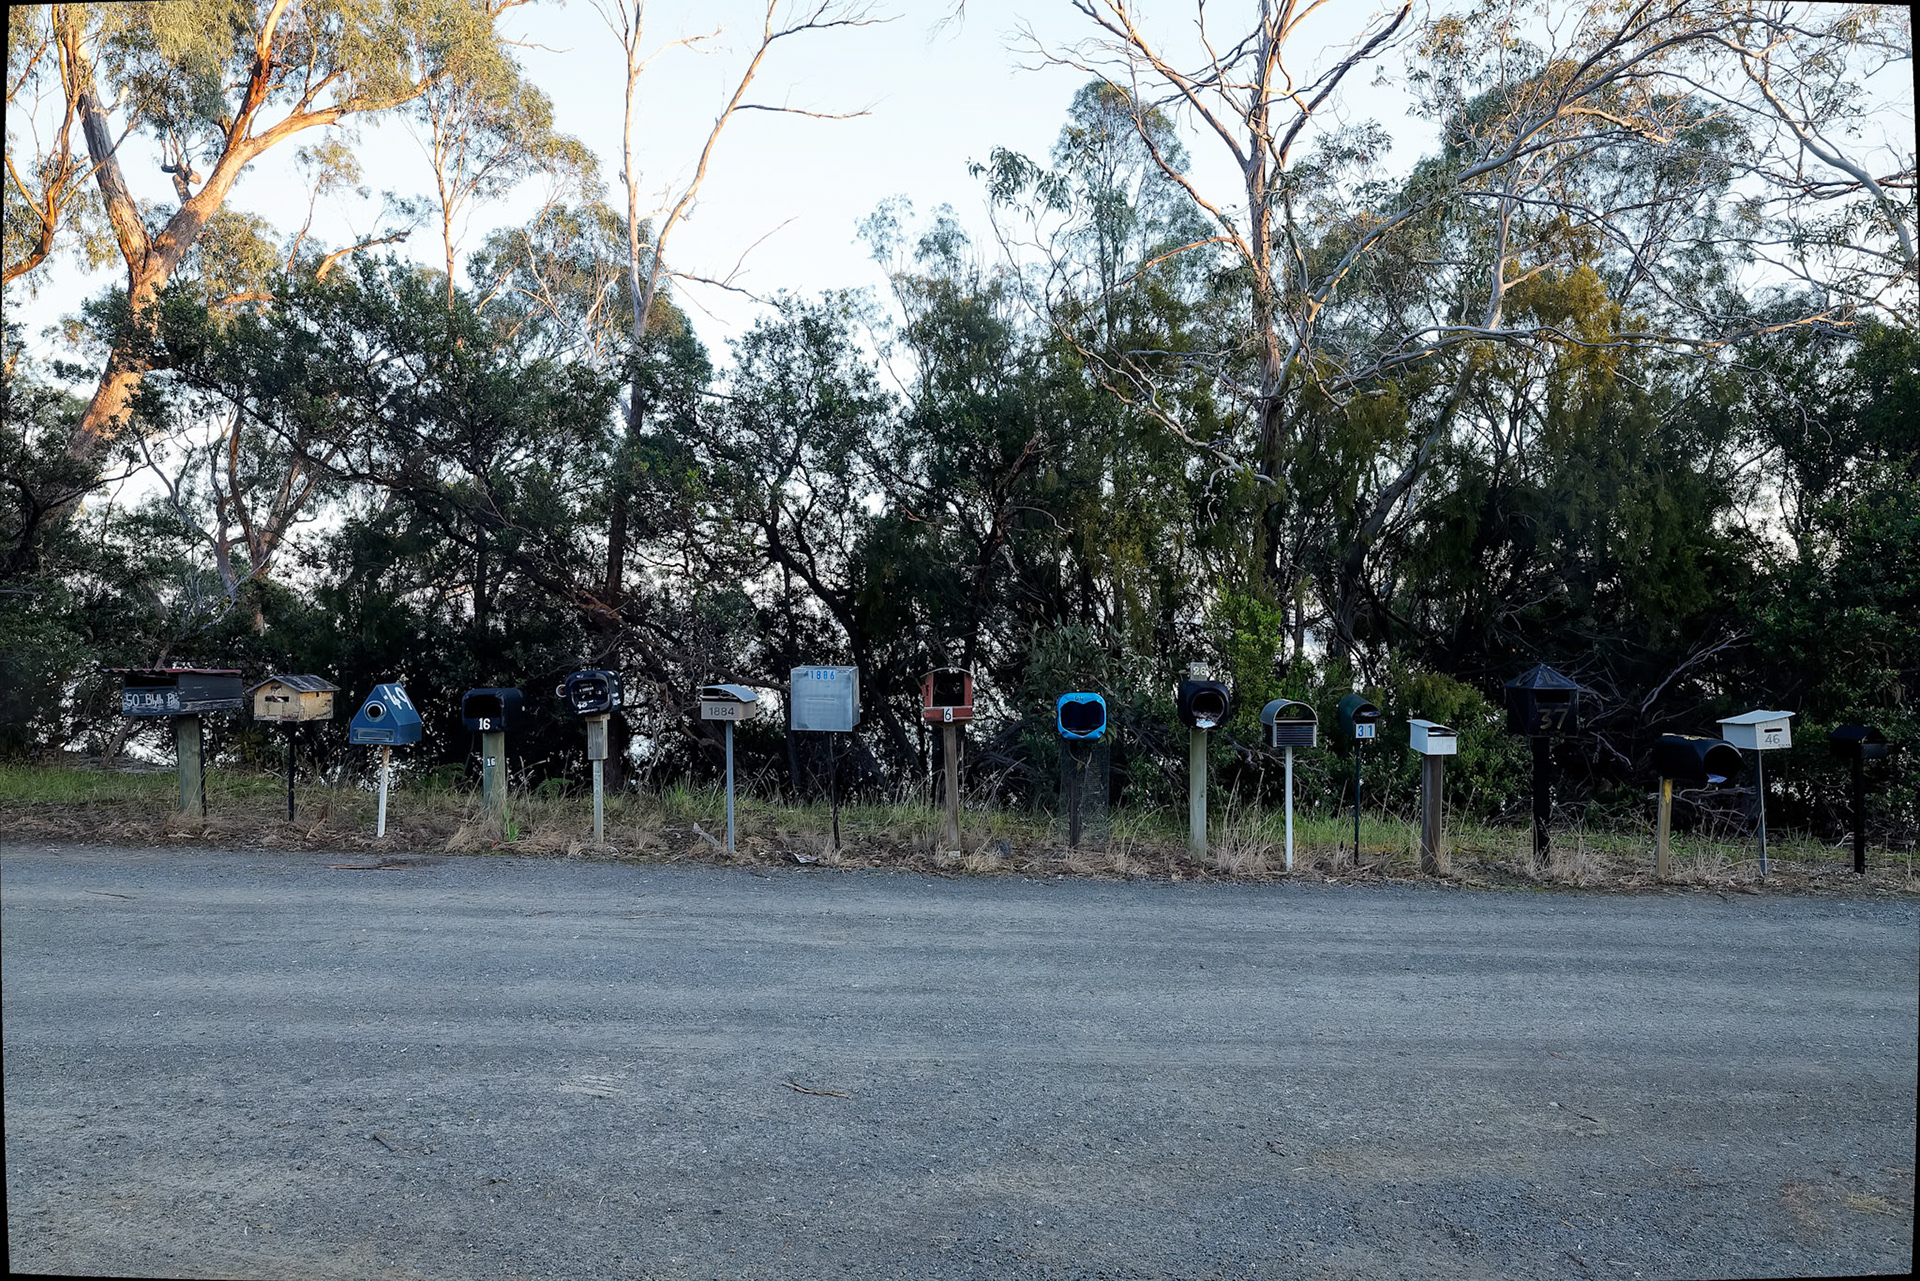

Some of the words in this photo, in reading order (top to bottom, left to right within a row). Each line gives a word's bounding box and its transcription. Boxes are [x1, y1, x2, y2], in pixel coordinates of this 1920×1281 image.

[810, 670, 835, 680] 1886
[1193, 666, 1207, 676] 26
[126, 693, 140, 707] 50
[709, 707, 735, 716] 1884
[944, 708, 952, 721] 6
[478, 717, 491, 730] 16
[1537, 708, 1569, 730] 37
[1357, 725, 1373, 737] 31
[1764, 734, 1780, 745] 46
[487, 758, 496, 767] 16
